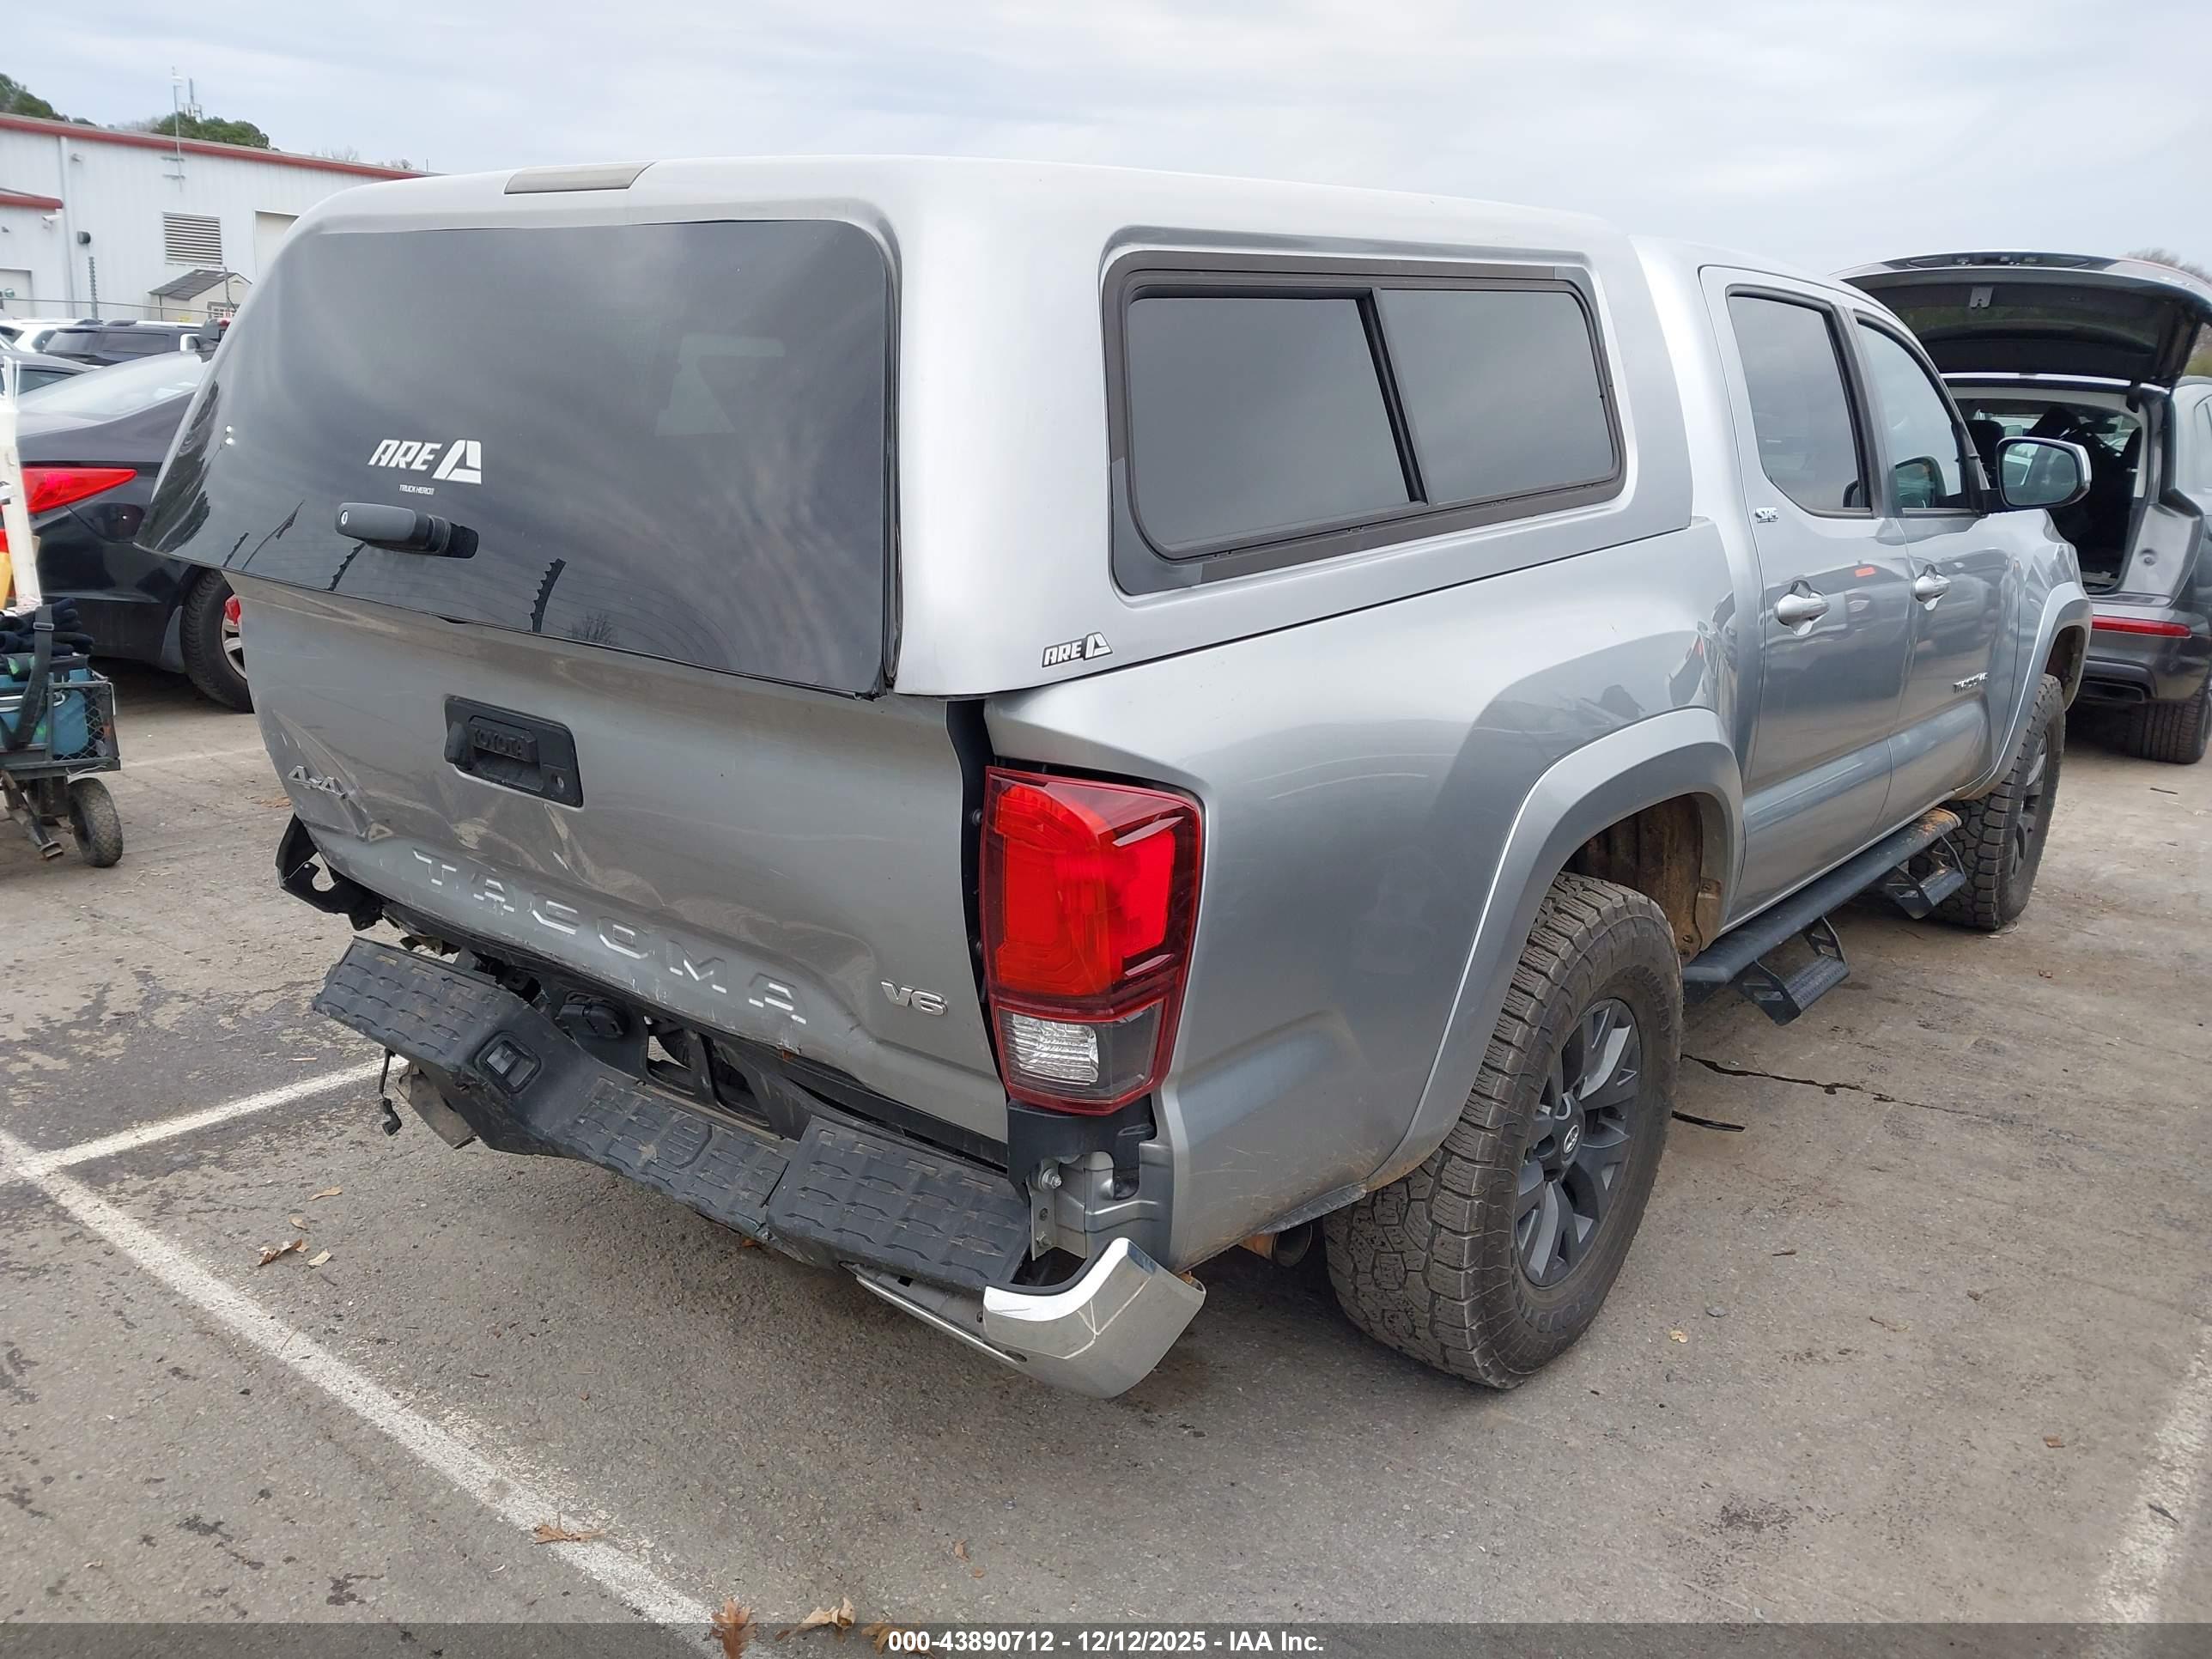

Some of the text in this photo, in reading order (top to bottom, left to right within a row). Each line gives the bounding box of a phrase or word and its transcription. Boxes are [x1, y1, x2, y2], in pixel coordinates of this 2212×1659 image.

[367, 439, 443, 471] ARE
[1042, 640, 1083, 666] ARE
[473, 726, 527, 760] TOYOTA
[413, 847, 807, 1025] TACOMA
[881, 979, 948, 1017] V6
